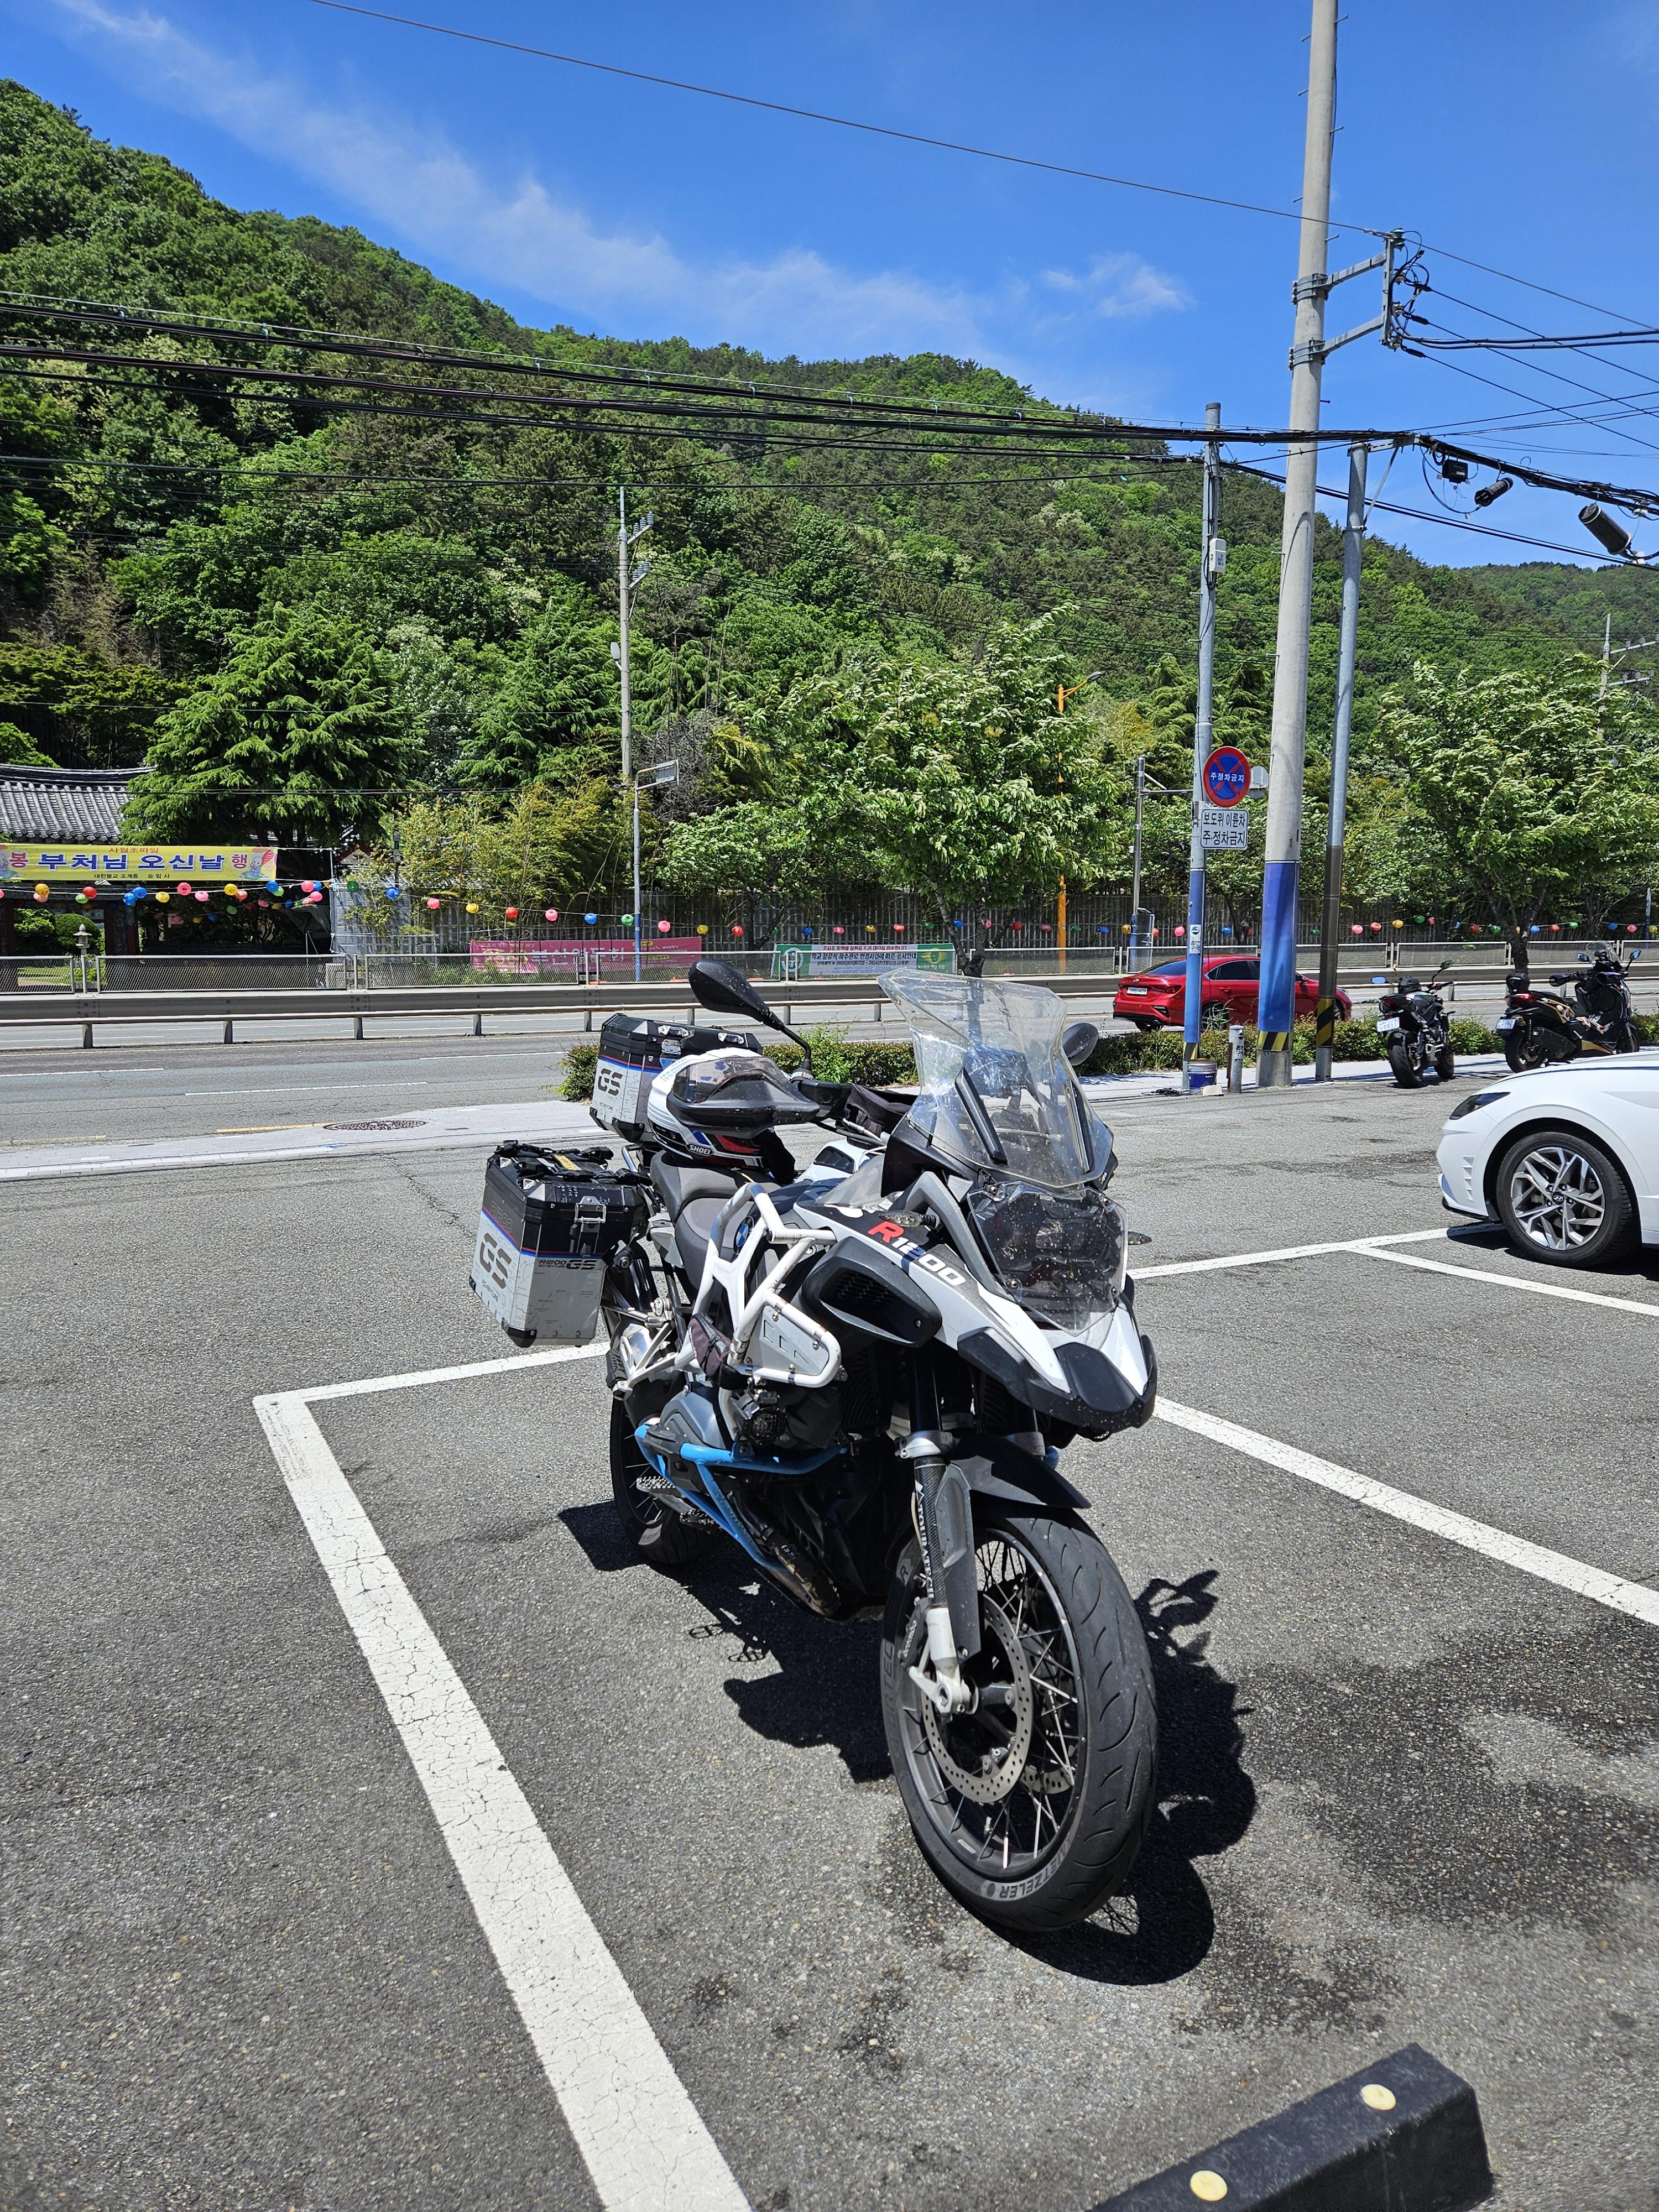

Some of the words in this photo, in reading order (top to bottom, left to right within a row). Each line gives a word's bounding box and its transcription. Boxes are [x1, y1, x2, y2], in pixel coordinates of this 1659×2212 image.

[1210, 772, 1244, 782] 주정차금지
[1203, 812, 1224, 826] 보도위
[1226, 812, 1246, 828] 이륜차
[9, 852, 28, 868] 봉
[38, 854, 127, 870] 부처님
[138, 854, 225, 870] 오신날
[231, 854, 248, 869] 행
[598, 1068, 623, 1096] GS
[689, 1145, 711, 1155] SHOEI
[479, 1232, 512, 1290] GS
[566, 1259, 597, 1270] GS
[867, 1220, 966, 1286] R1200
[917, 1504, 935, 1599] TOURATECH
[902, 1620, 918, 1658] brembo
[999, 1839, 1070, 1899] METZELER
